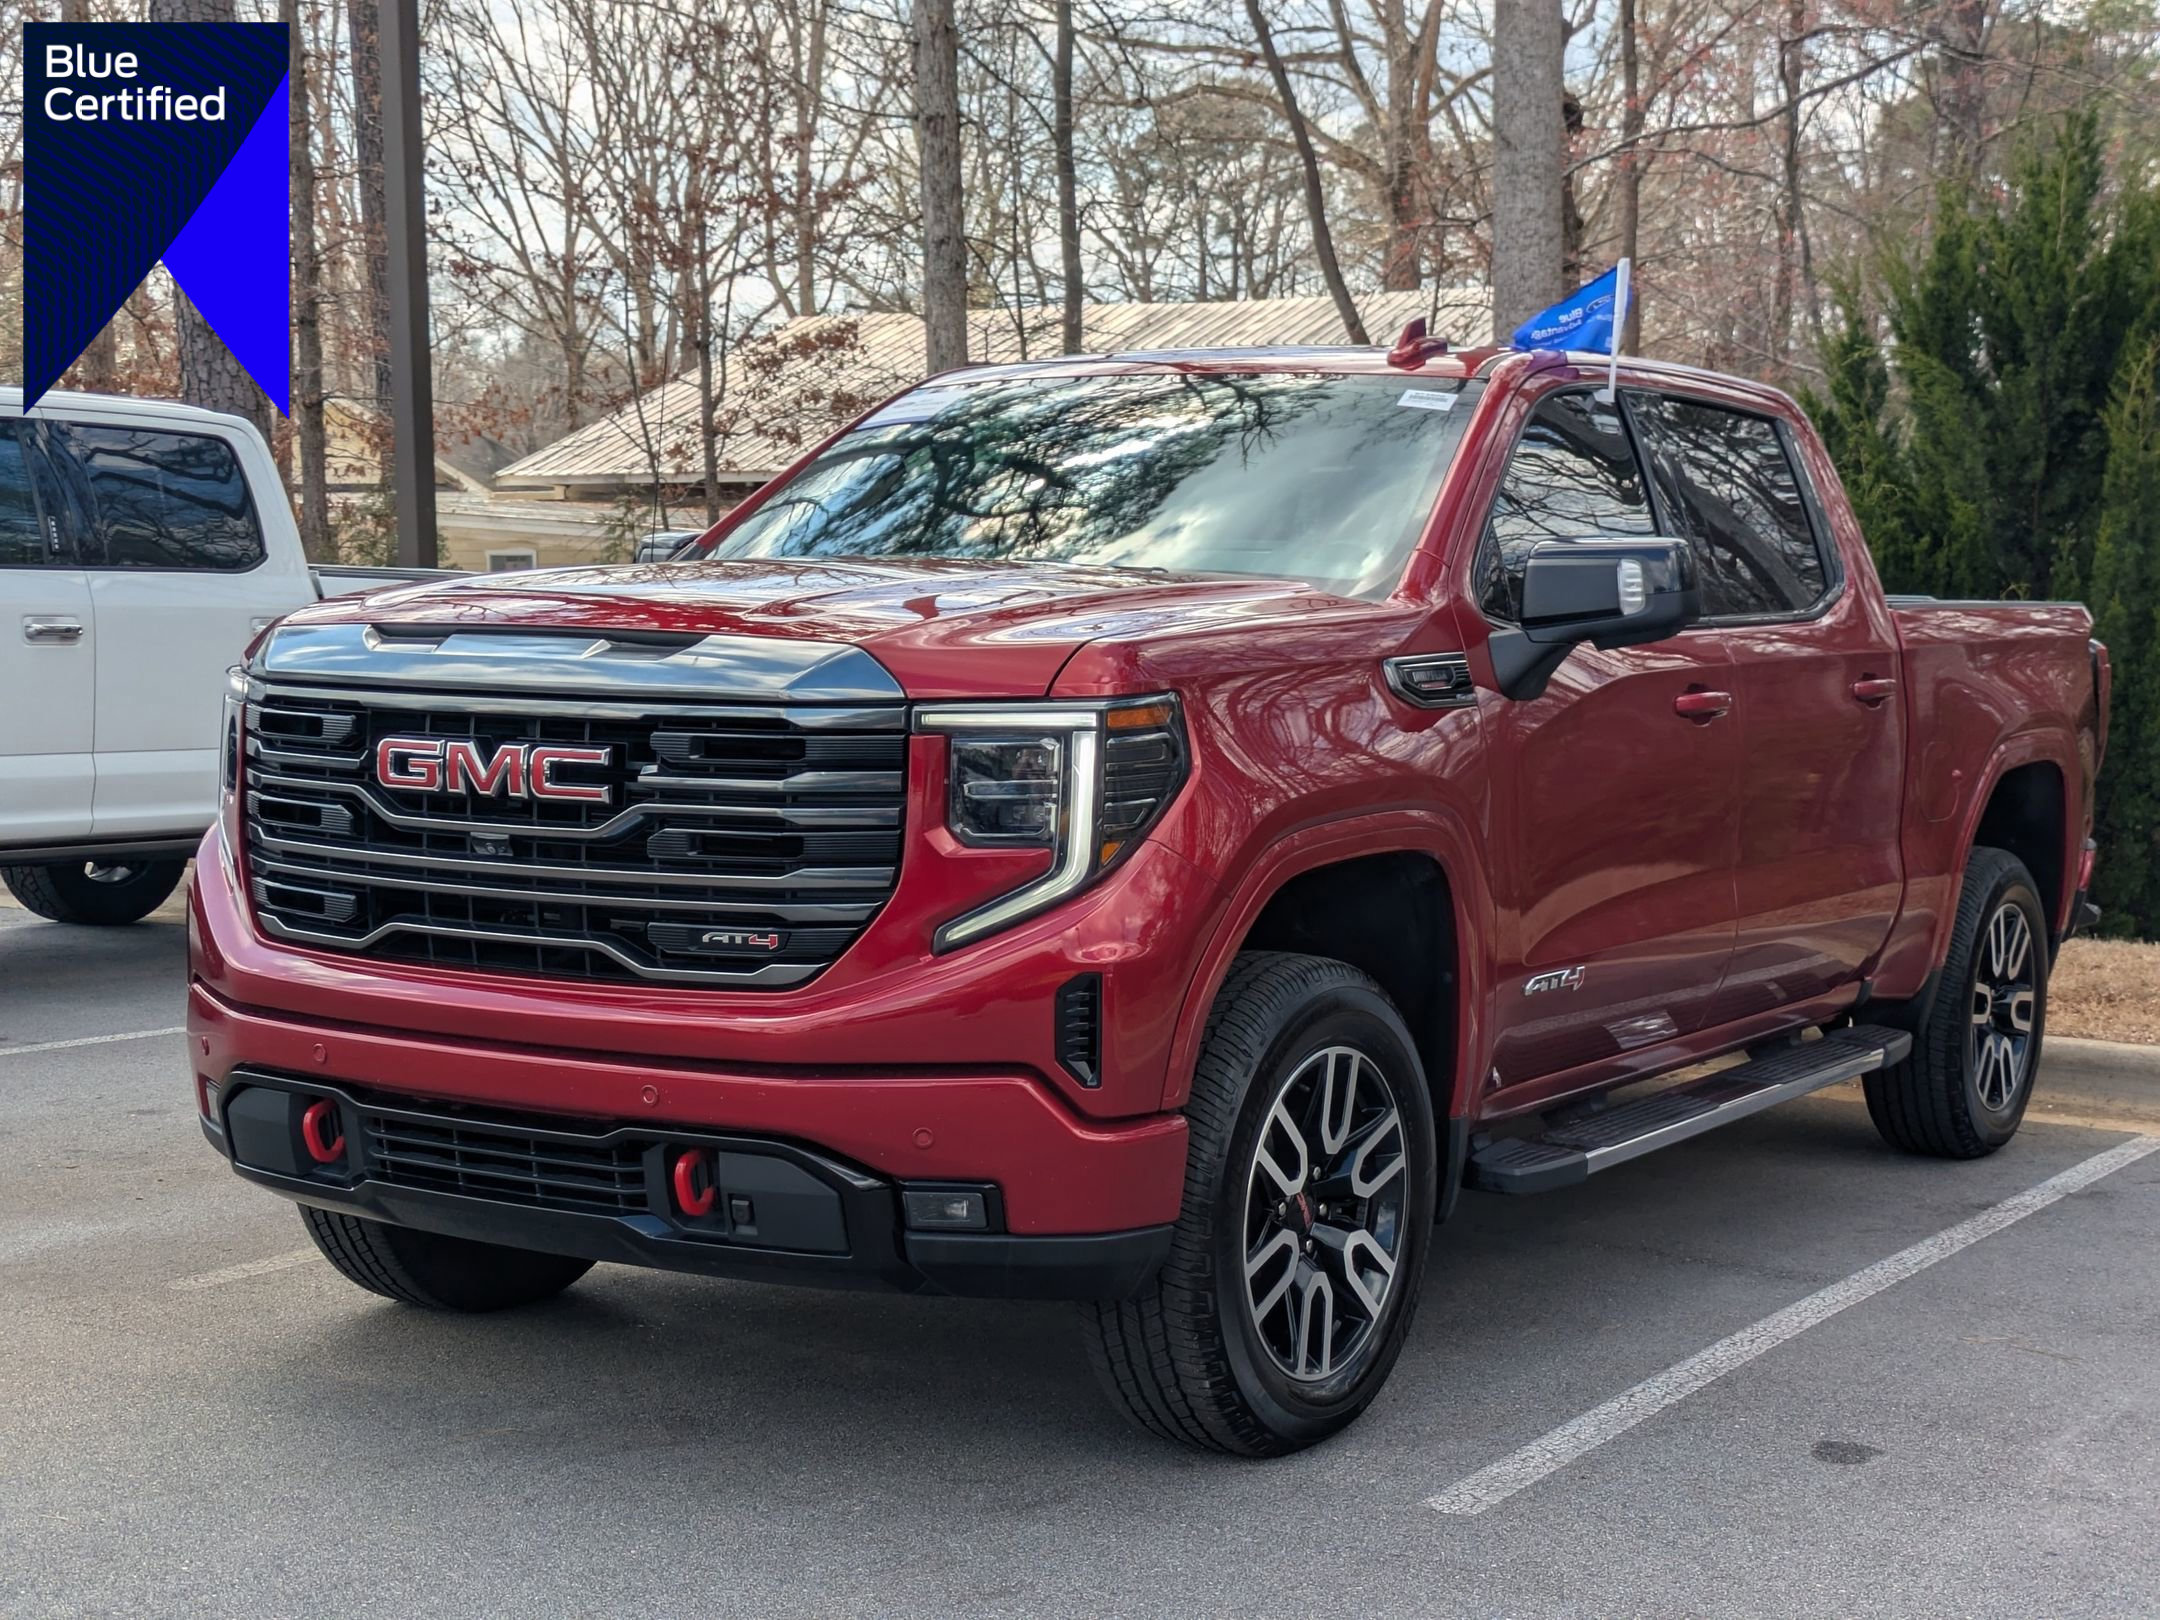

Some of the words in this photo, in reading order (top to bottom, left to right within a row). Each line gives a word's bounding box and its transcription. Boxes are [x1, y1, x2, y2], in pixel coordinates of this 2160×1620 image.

[376, 737, 612, 805] GMC
[702, 931, 778, 950] AT4
[1524, 965, 1586, 996] AT4
